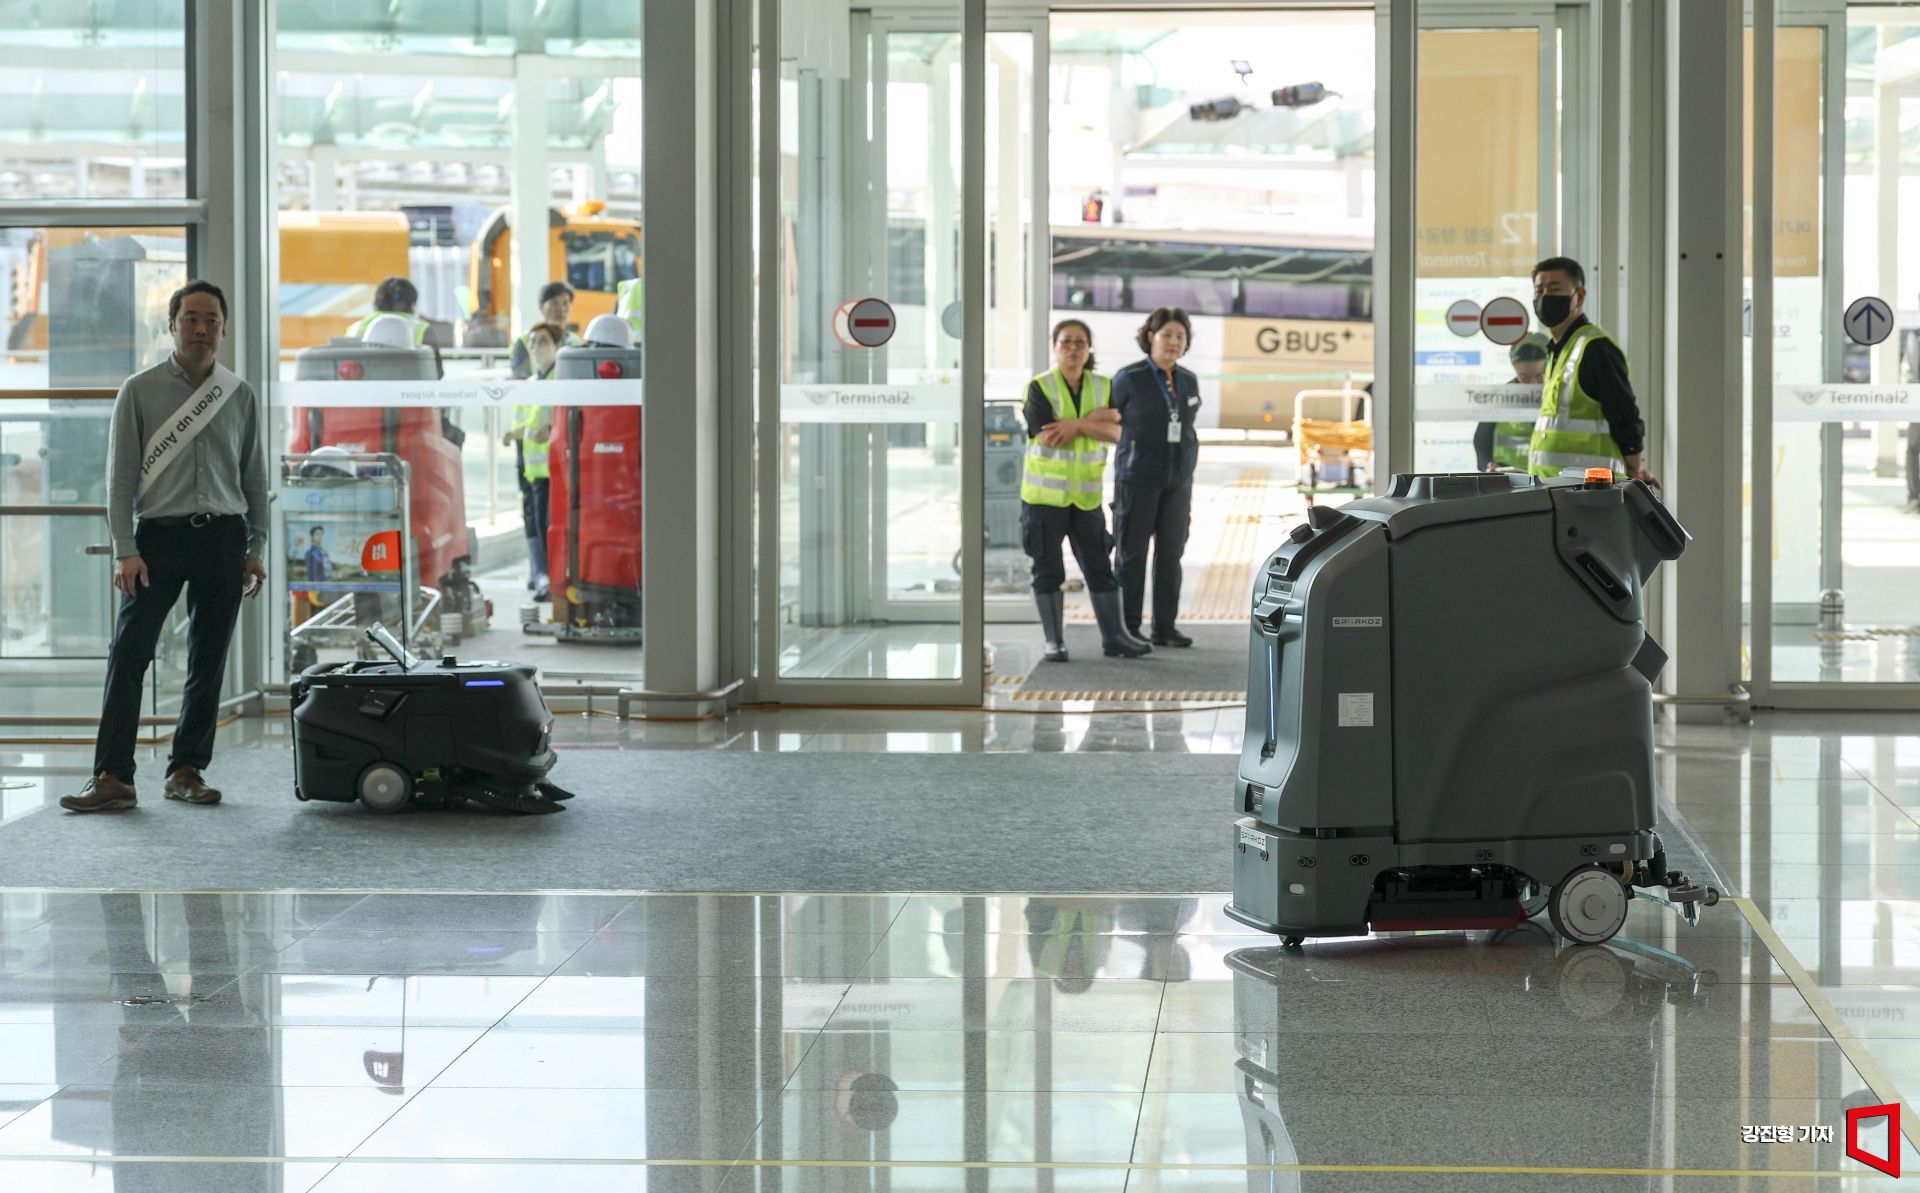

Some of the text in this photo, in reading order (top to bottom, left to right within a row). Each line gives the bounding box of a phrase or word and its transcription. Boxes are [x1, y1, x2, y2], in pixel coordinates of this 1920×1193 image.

[832, 390, 911, 405] Terminal2
[1829, 390, 1909, 404] Terminal2
[141, 385, 223, 476] Clean up Airport
